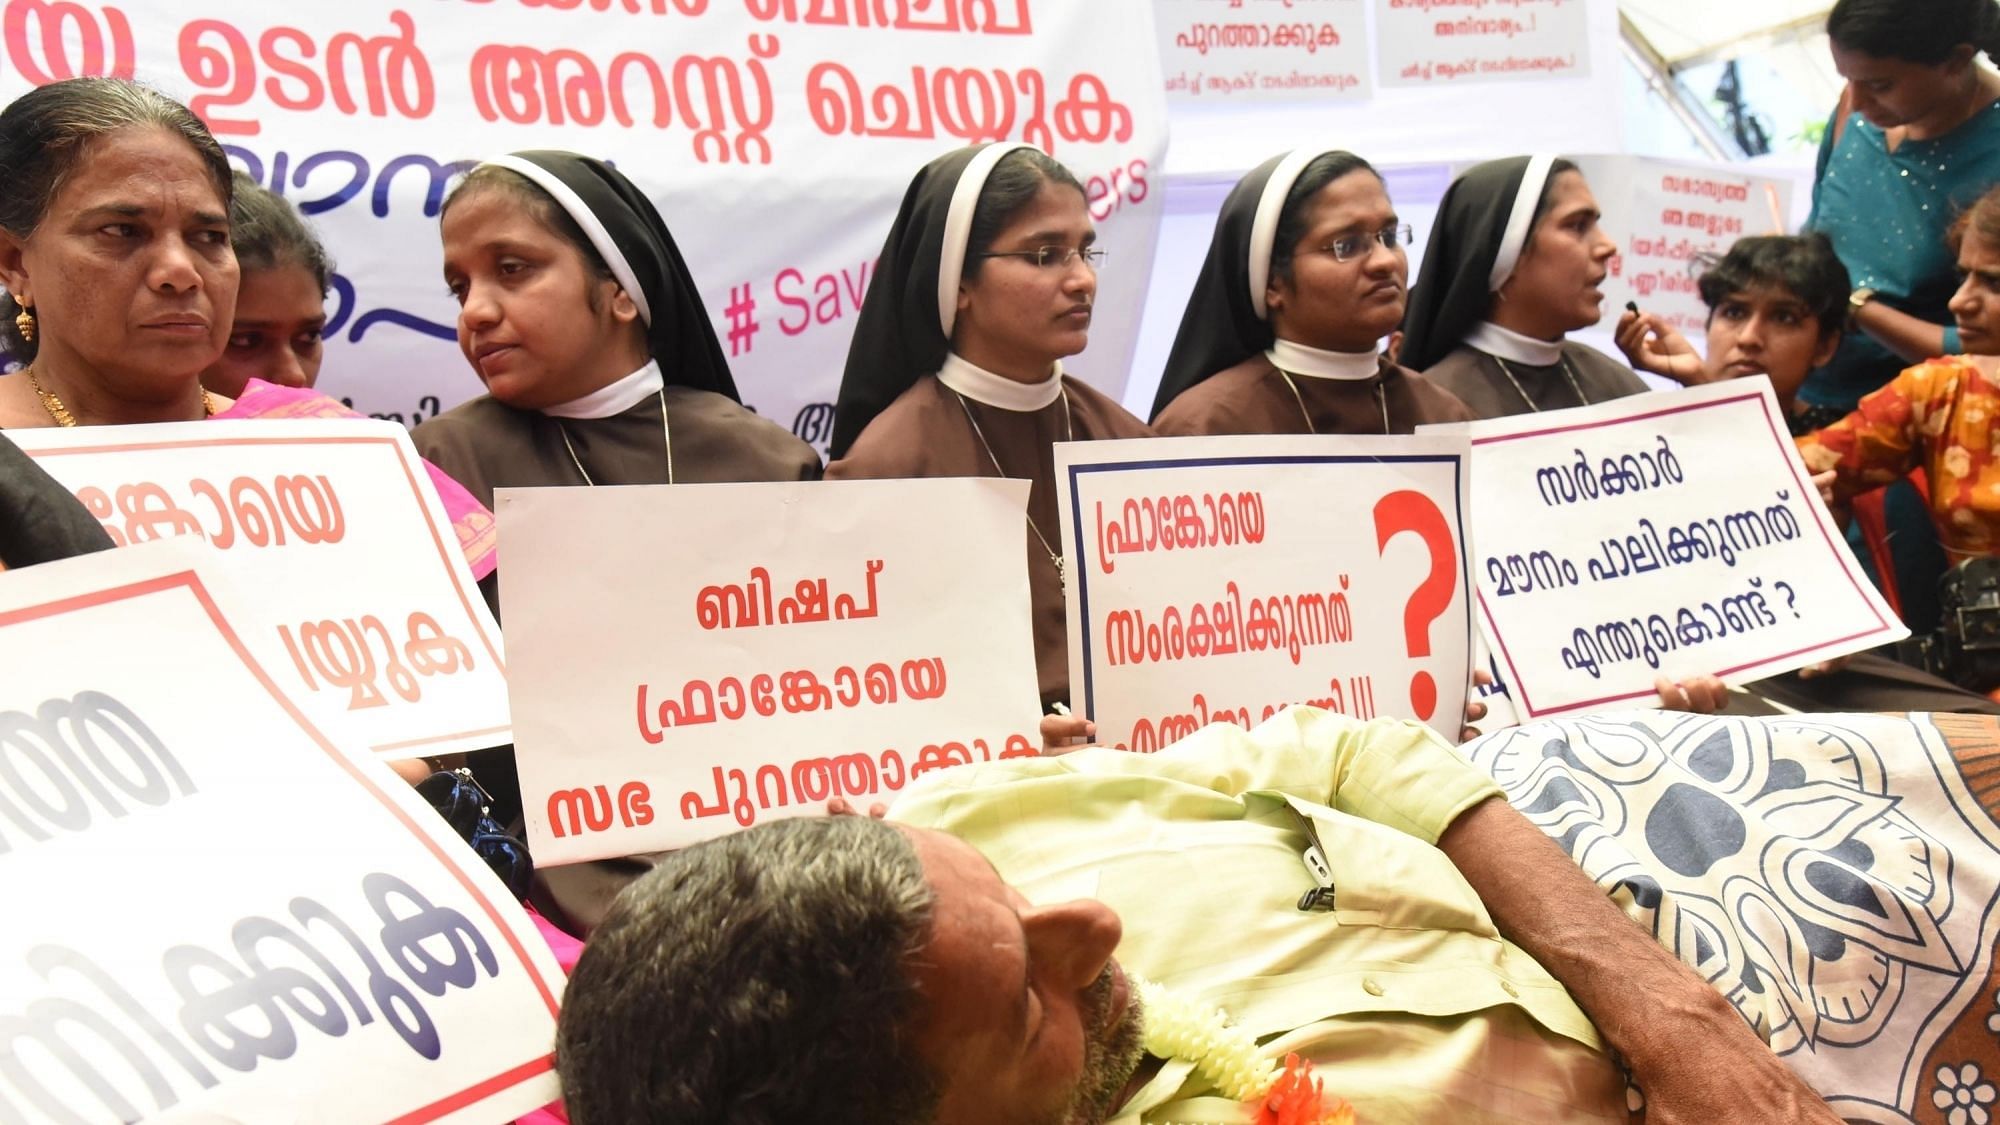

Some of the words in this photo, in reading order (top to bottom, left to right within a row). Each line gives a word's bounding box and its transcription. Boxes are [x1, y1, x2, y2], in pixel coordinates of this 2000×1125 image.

[1177, 23, 1340, 54] പുറത്താക്കുക
[178, 10, 435, 136] ഉടൻ
[470, 33, 779, 164] അറസ്റ്റ്
[806, 62, 1133, 152] ചെയ്യുക
[724, 283, 760, 357] #
[774, 264, 876, 336] Sav
[1537, 435, 1684, 507] സർക്കാർ
[1096, 491, 1265, 575] ഫ്രാങ്കോയെ
[1486, 544, 1578, 597] മൗനം
[1587, 490, 1802, 584] പാലിക്കുന്നത്
[696, 559, 884, 631] ബിഷപ്
[1105, 573, 1353, 666] സംരക്ഷിക്കുന്നത്
[1561, 576, 1776, 679] എന്തുകൊണ്ട്
[1774, 581, 1802, 619] ?
[277, 611, 475, 711] യ്യുക
[636, 656, 947, 744] ഫ്രാങ്കോയെ
[546, 779, 655, 838] സഭ
